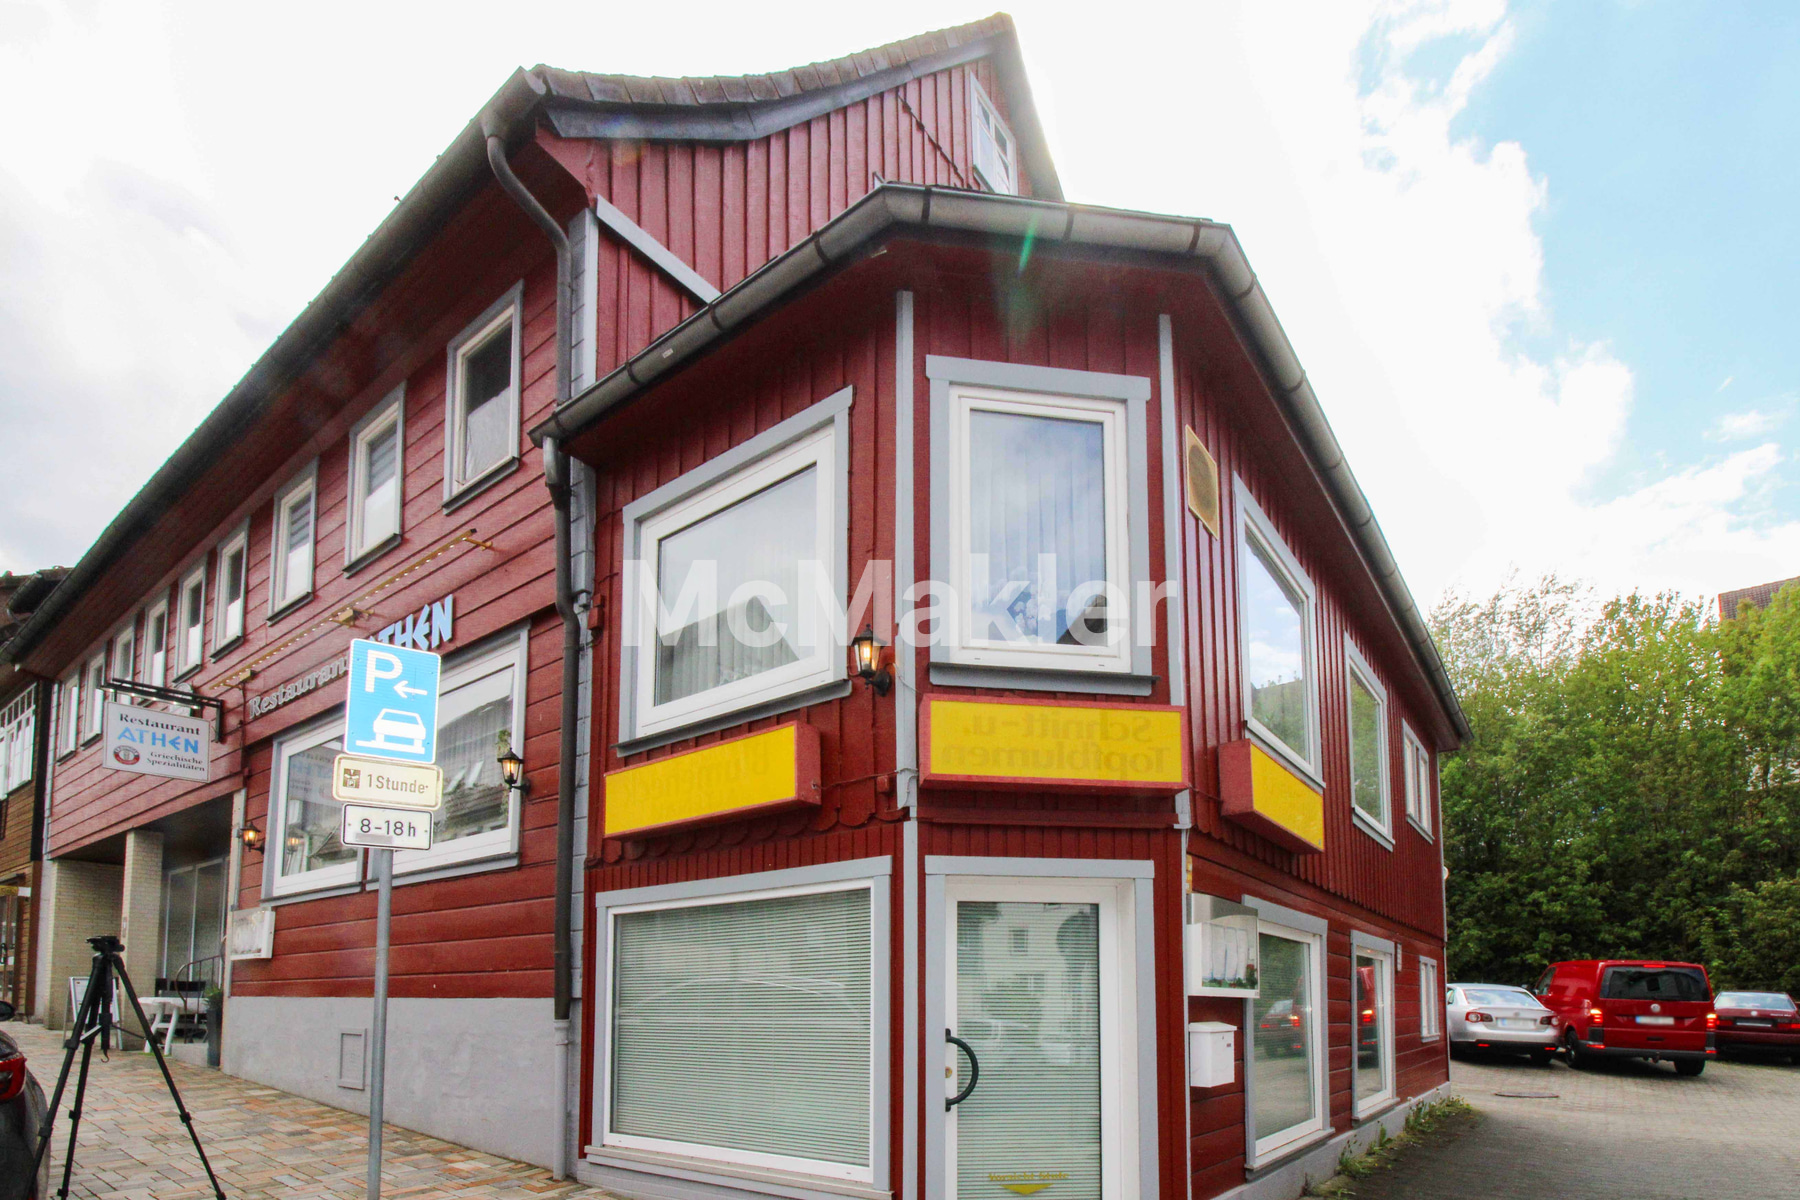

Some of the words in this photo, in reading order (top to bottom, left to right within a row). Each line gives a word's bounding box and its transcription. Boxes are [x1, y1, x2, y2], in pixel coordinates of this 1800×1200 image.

[369, 594, 453, 651] THEN
[365, 650, 403, 693] P
[120, 714, 200, 735] Restaurant
[117, 727, 199, 754] ATHEN
[147, 758, 205, 771] Spezialitäten
[151, 752, 203, 764] Griechische
